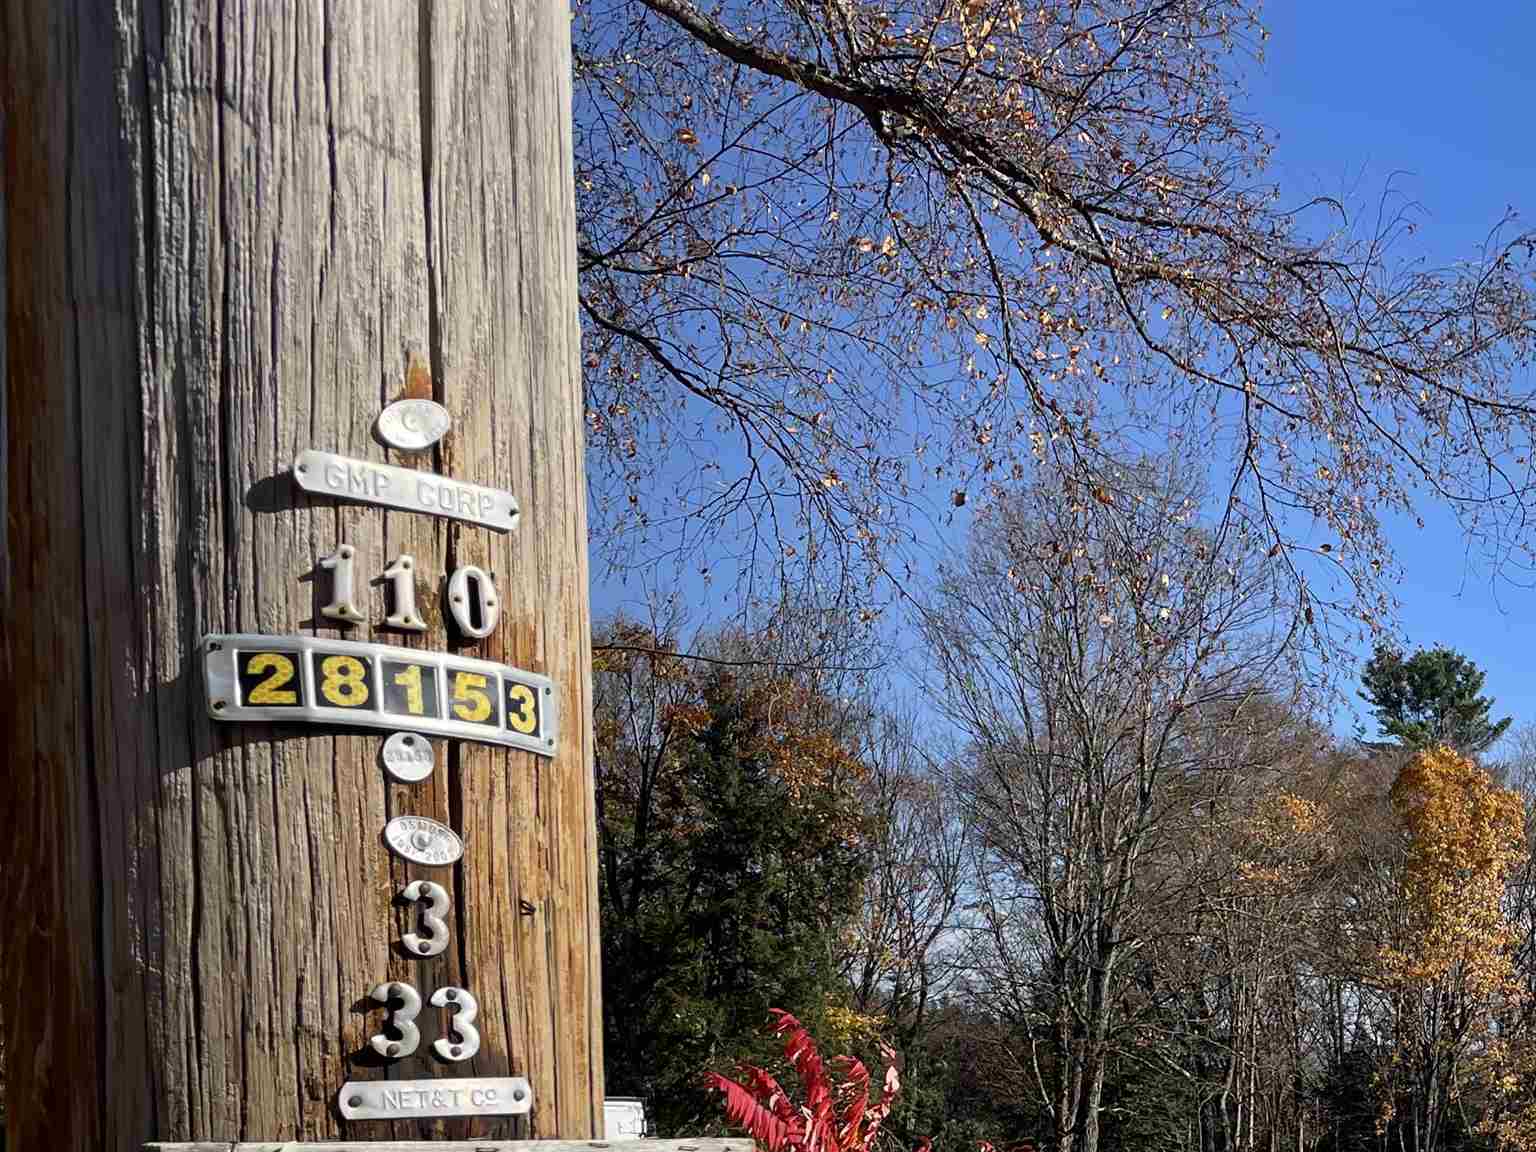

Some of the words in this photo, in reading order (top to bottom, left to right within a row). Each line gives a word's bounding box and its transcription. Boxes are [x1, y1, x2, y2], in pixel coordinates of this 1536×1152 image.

[324, 463, 393, 497] GMP
[416, 478, 495, 518] CORP
[319, 543, 499, 639] 110
[247, 653, 537, 734] 28153
[401, 879, 451, 956] 3
[369, 981, 481, 1061] 33
[381, 1088, 465, 1110] NET&T
